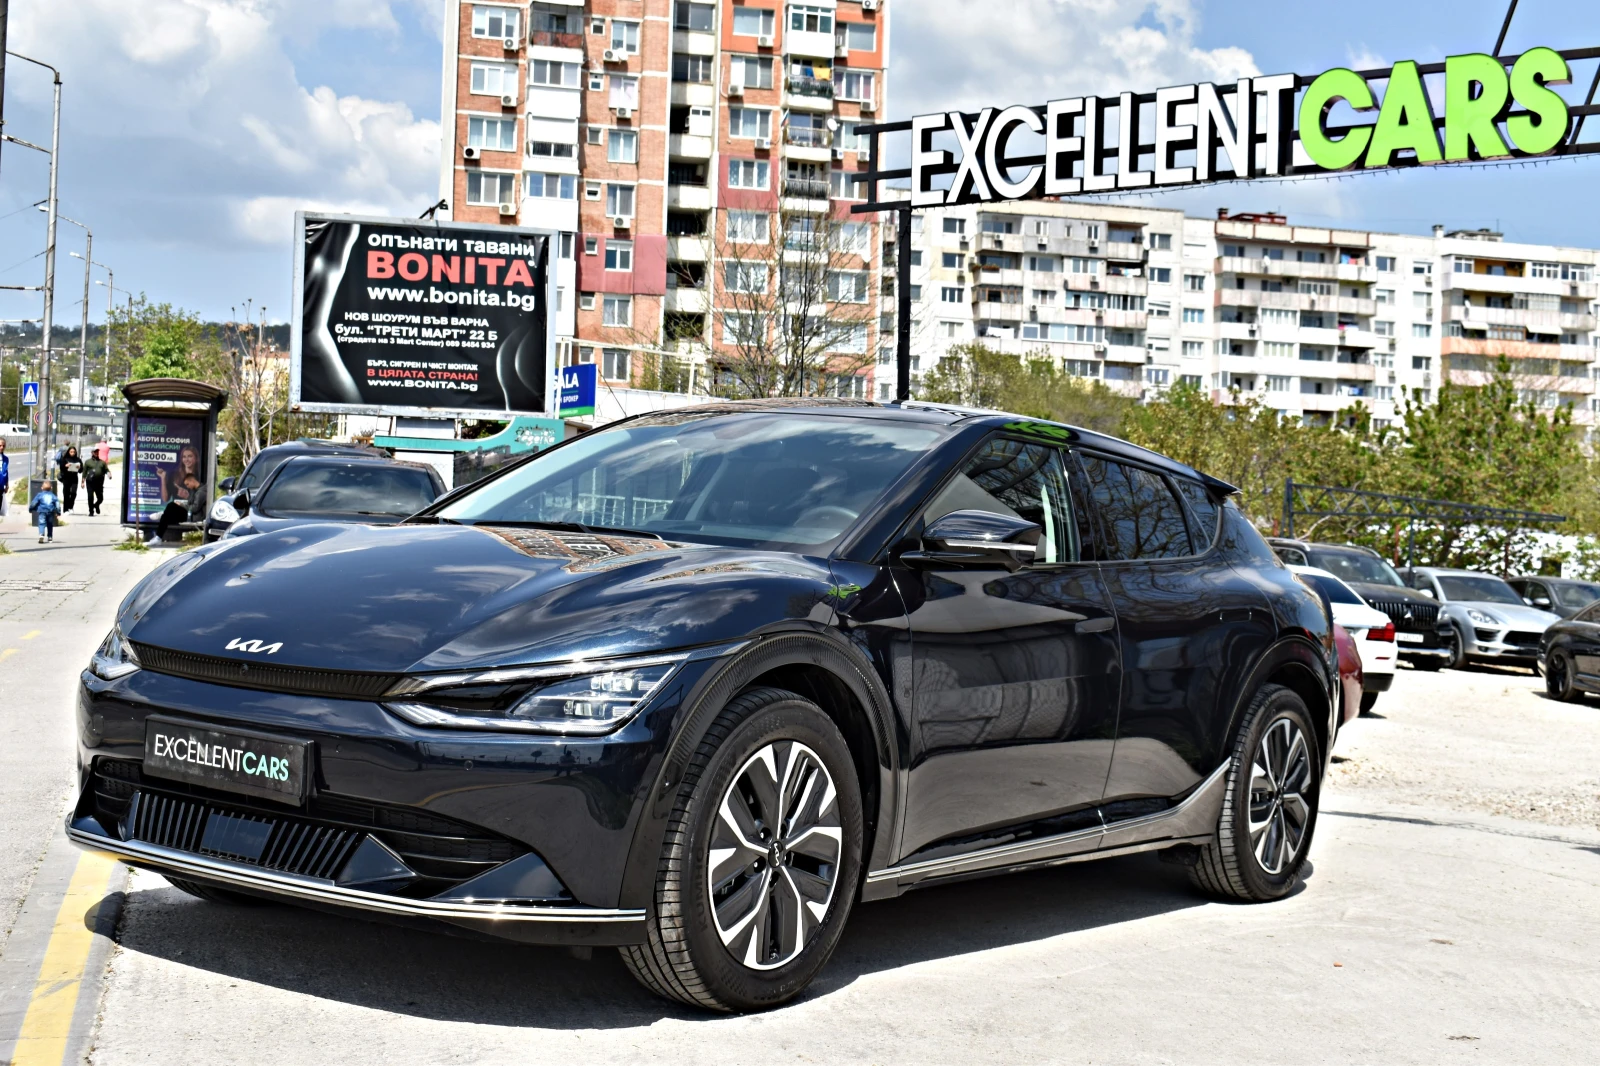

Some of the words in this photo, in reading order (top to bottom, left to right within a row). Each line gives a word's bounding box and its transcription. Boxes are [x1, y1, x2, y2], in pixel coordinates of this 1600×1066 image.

[367, 233, 458, 252] опънати
[463, 239, 535, 257] тавани
[367, 250, 535, 287] BONITA
[367, 286, 535, 312] www.bonita.bg
[344, 311, 369, 321] НОВ
[371, 313, 421, 324] ШОУРУМ
[422, 315, 449, 325] ВЪВ
[450, 317, 490, 327] ВАРНА
[334, 323, 364, 337] бул.
[469, 329, 485, 341] 22
[487, 330, 498, 341] Б
[480, 341, 496, 349] 934
[389, 360, 421, 369] СИГУРЕН
[447, 363, 478, 371] МОНТАЖ
[367, 368, 376, 377] В
[378, 369, 426, 378] ЦЯЛАТА
[428, 371, 478, 380] СТРАНА!
[367, 379, 478, 392] www.BONITA.bg
